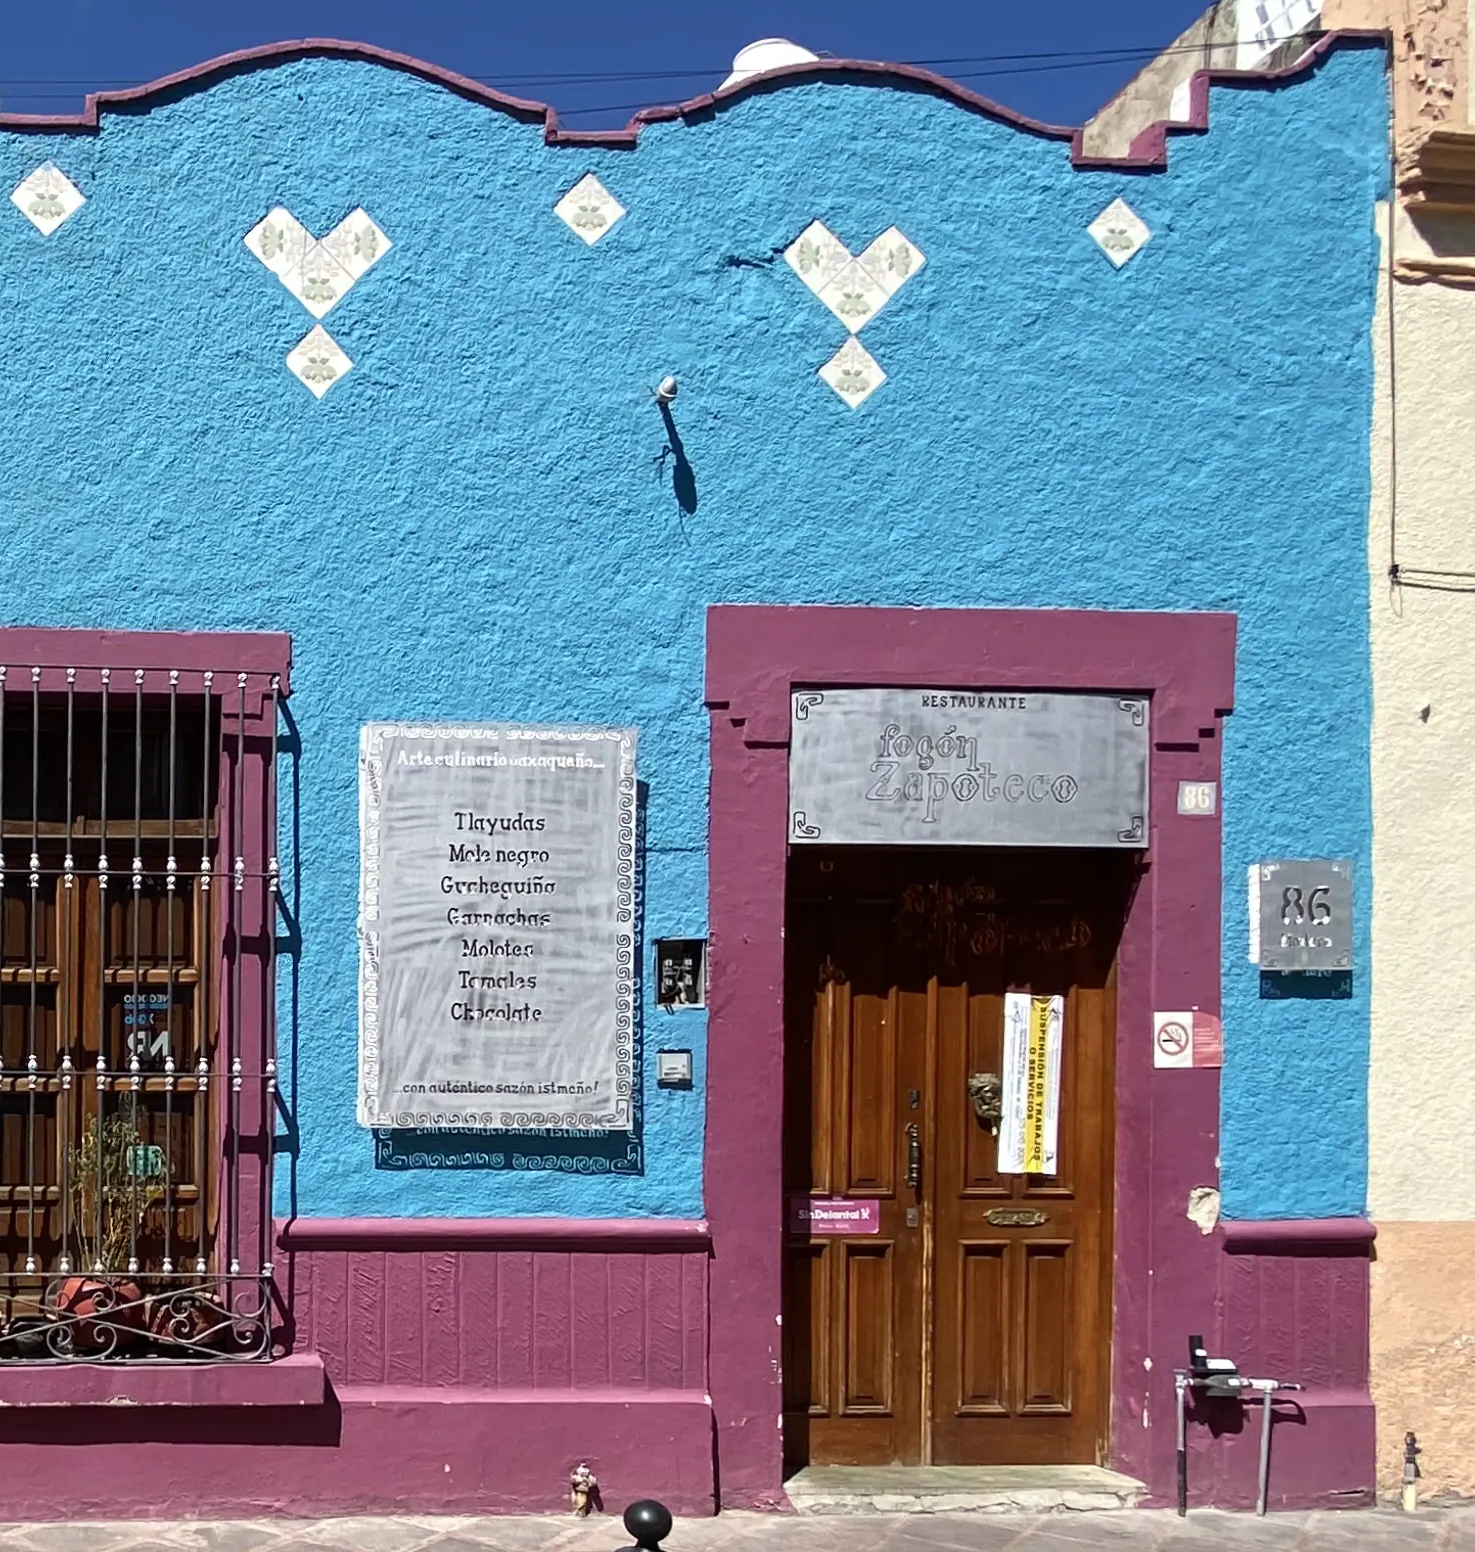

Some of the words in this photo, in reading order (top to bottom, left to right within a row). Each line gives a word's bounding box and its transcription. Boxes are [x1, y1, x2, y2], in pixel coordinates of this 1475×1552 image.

[921, 695, 1027, 710] RESTAURANTE
[879, 724, 980, 771] fogón
[397, 750, 433, 766] Arte
[865, 761, 1078, 823] Zapoteco
[1185, 786, 1210, 808] 86
[454, 812, 546, 835] Tlayudas
[449, 844, 491, 862] Mole
[496, 850, 549, 868] negro
[1281, 885, 1331, 926] 86
[447, 907, 551, 926] Garnachas
[461, 939, 534, 957] Molotes
[458, 970, 537, 989] Tamales
[451, 1002, 542, 1021] Chocolate
[1029, 1047, 1036, 1055] O
[1036, 1006, 1046, 1079] SUSPENSIÓN
[429, 1081, 493, 1094] auténtico
[495, 1081, 535, 1094] sazón
[538, 1081, 600, 1094] istmeño!
[1027, 1058, 1036, 1121] SERVICIOS
[1035, 1083, 1043, 1097] DE
[1033, 1102, 1043, 1161] TRABAJOS
